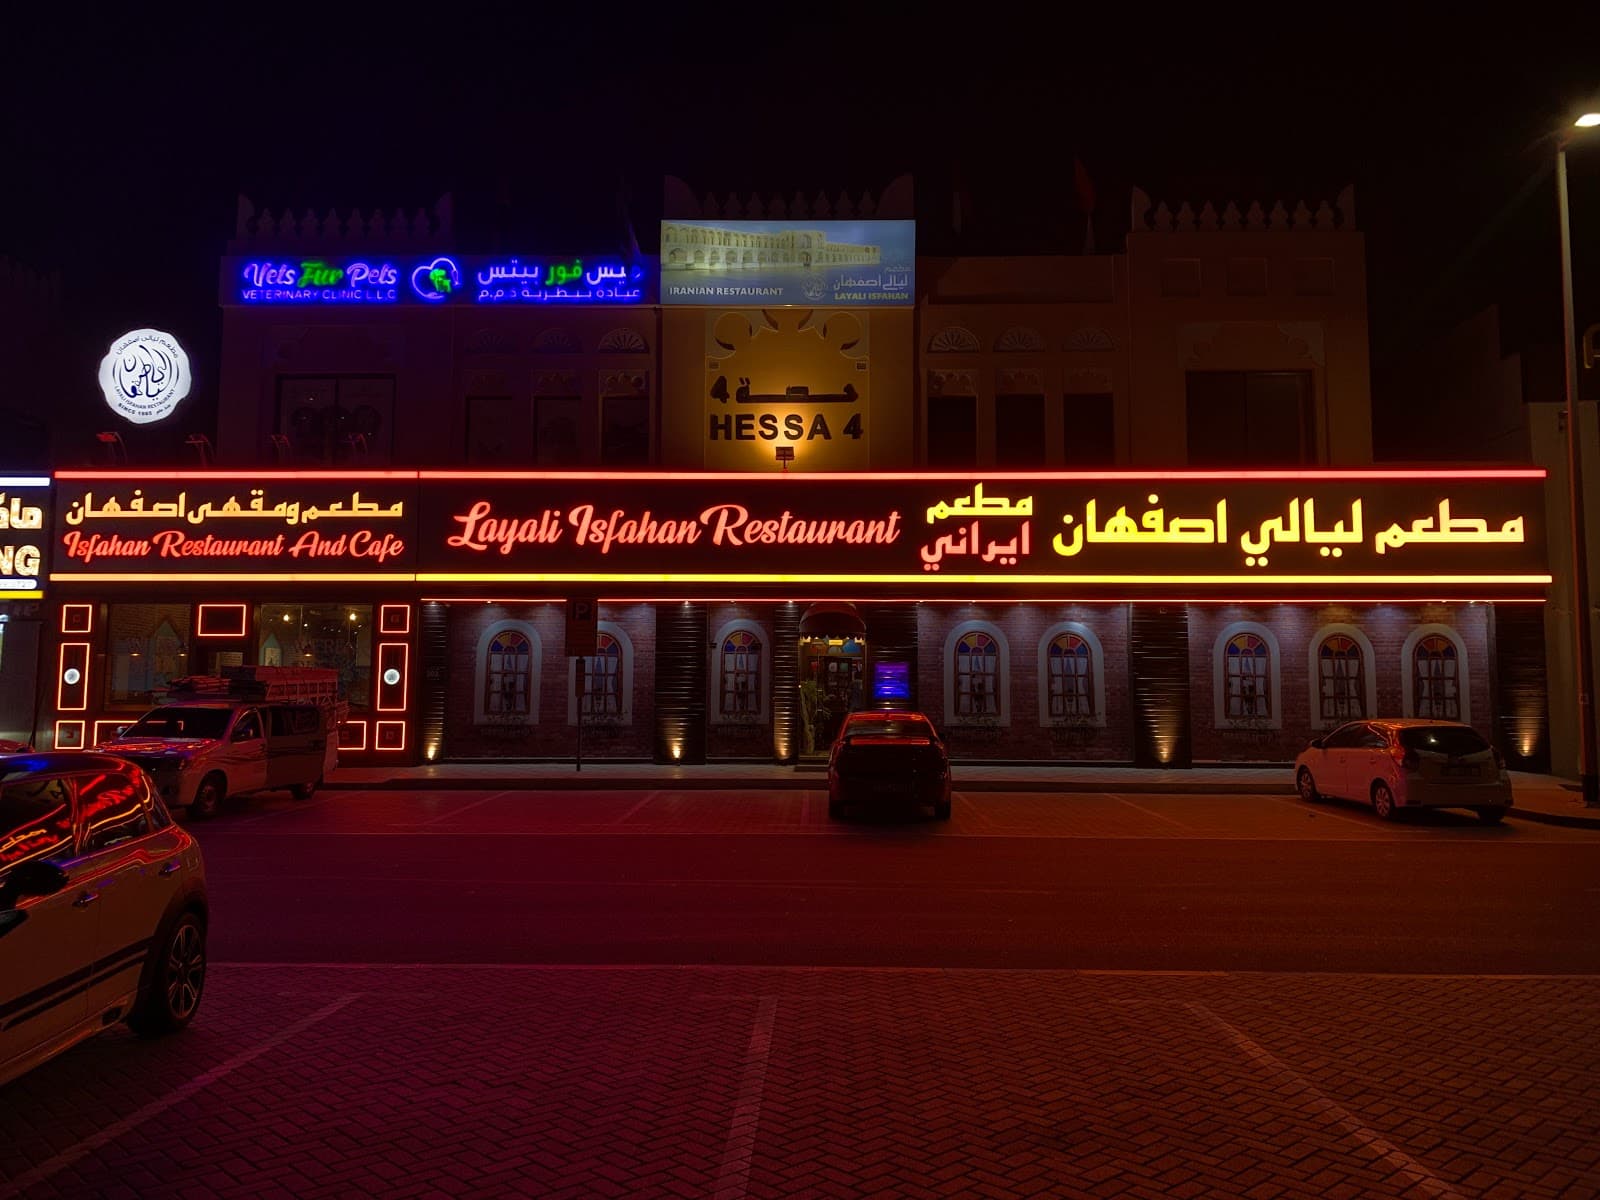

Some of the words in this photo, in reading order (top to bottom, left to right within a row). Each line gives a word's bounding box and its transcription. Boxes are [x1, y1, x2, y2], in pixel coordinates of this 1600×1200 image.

[243, 263, 296, 287] Vets
[297, 261, 344, 288] Fur
[346, 263, 397, 287] Pets
[545, 259, 583, 286] فور
[669, 287, 714, 296] IRANIAN
[716, 287, 784, 296] RESTAURANT
[834, 292, 866, 300] LAYALI
[709, 413, 832, 441] HESSA
[842, 413, 864, 440] 4
[66, 489, 186, 526] اصفهان
[301, 491, 403, 524] مطعم
[926, 482, 1033, 525] مطعم
[446, 501, 563, 554] Layali
[568, 504, 702, 554] Isfahan
[700, 504, 902, 546] Restaurant
[1052, 494, 1229, 557] اصفهان
[1240, 497, 1363, 567] ليالي
[1374, 497, 1526, 555] مطعم
[63, 530, 151, 563] Isfahan
[153, 530, 285, 558] Restaurant
[289, 530, 348, 558] And
[348, 530, 404, 563] Cafe
[920, 521, 1032, 571] ايراني
